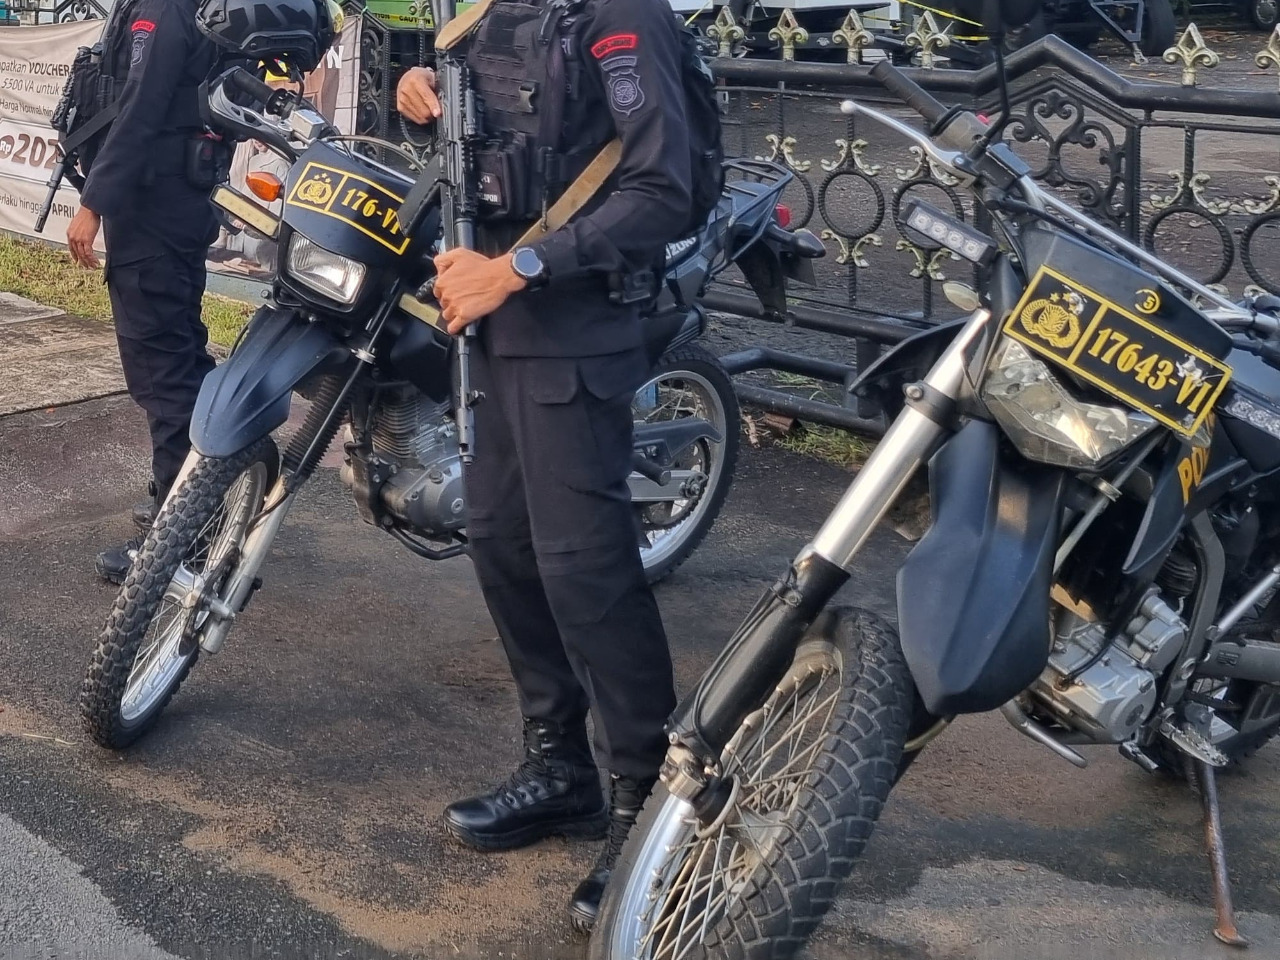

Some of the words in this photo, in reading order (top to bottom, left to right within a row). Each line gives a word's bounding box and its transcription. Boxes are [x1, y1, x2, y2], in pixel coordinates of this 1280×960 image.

[28, 62, 71, 77] VOUCHER
[1, 77, 23, 92] 5500
[24, 80, 35, 93] VA
[36, 82, 60, 96] untuk
[0, 98, 18, 113] Harga
[1087, 327, 1212, 414] 17643-VI
